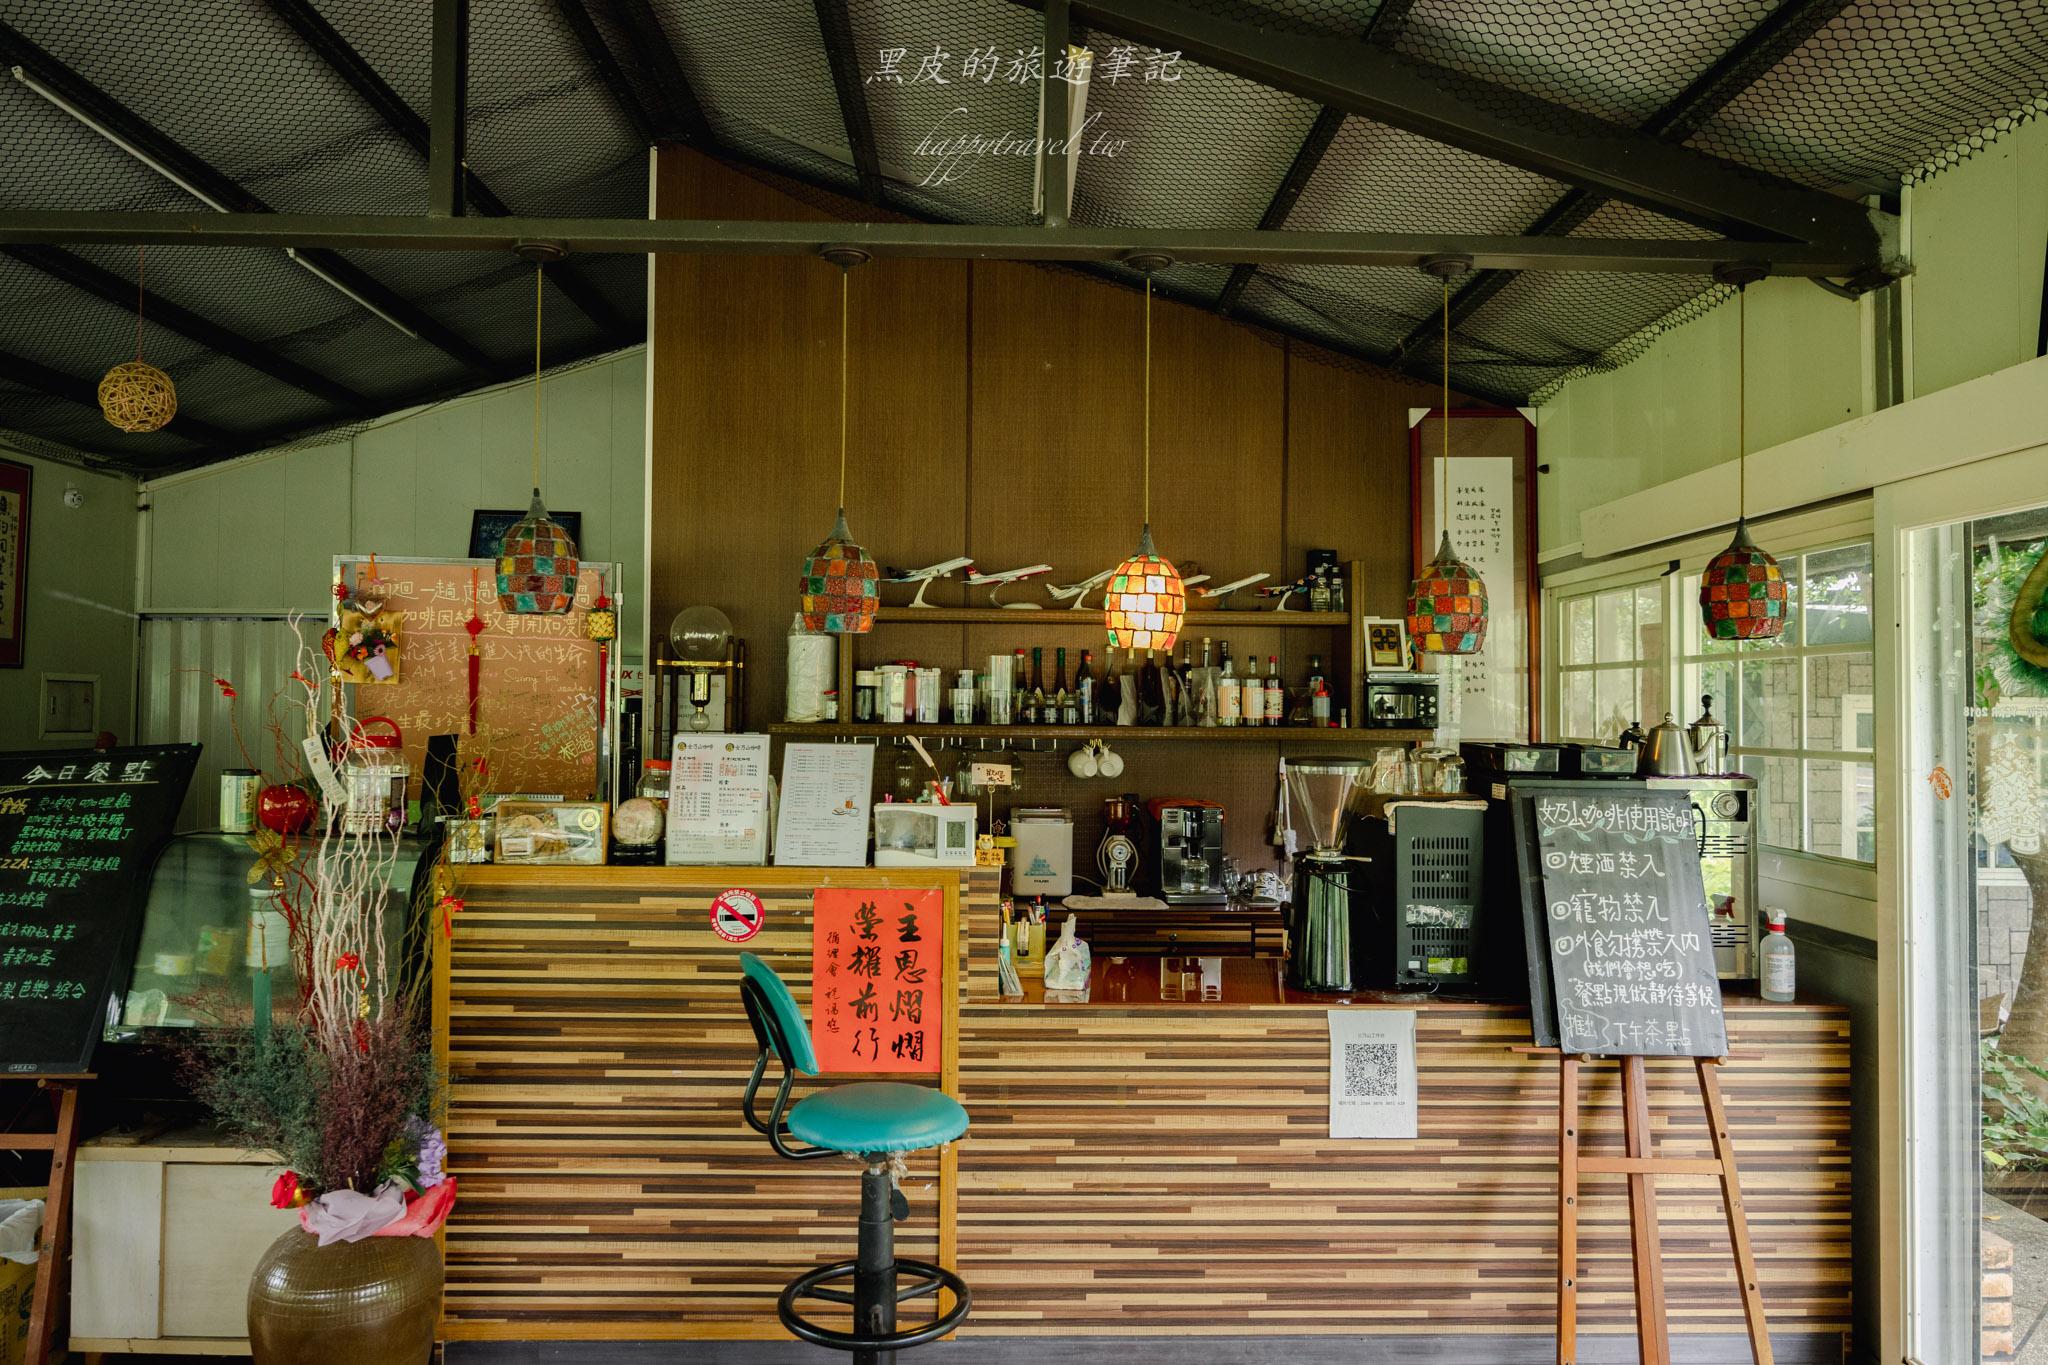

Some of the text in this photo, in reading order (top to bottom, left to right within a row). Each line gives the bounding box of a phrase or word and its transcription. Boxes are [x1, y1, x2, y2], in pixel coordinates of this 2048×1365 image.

[22, 760, 153, 784] 今日餐點
[1568, 850, 1665, 879] 煙酒禁入
[1569, 889, 1669, 924] 寵物禁入
[847, 900, 884, 1062] 榮耀前行
[1612, 1018, 1694, 1047] 下午茶點
